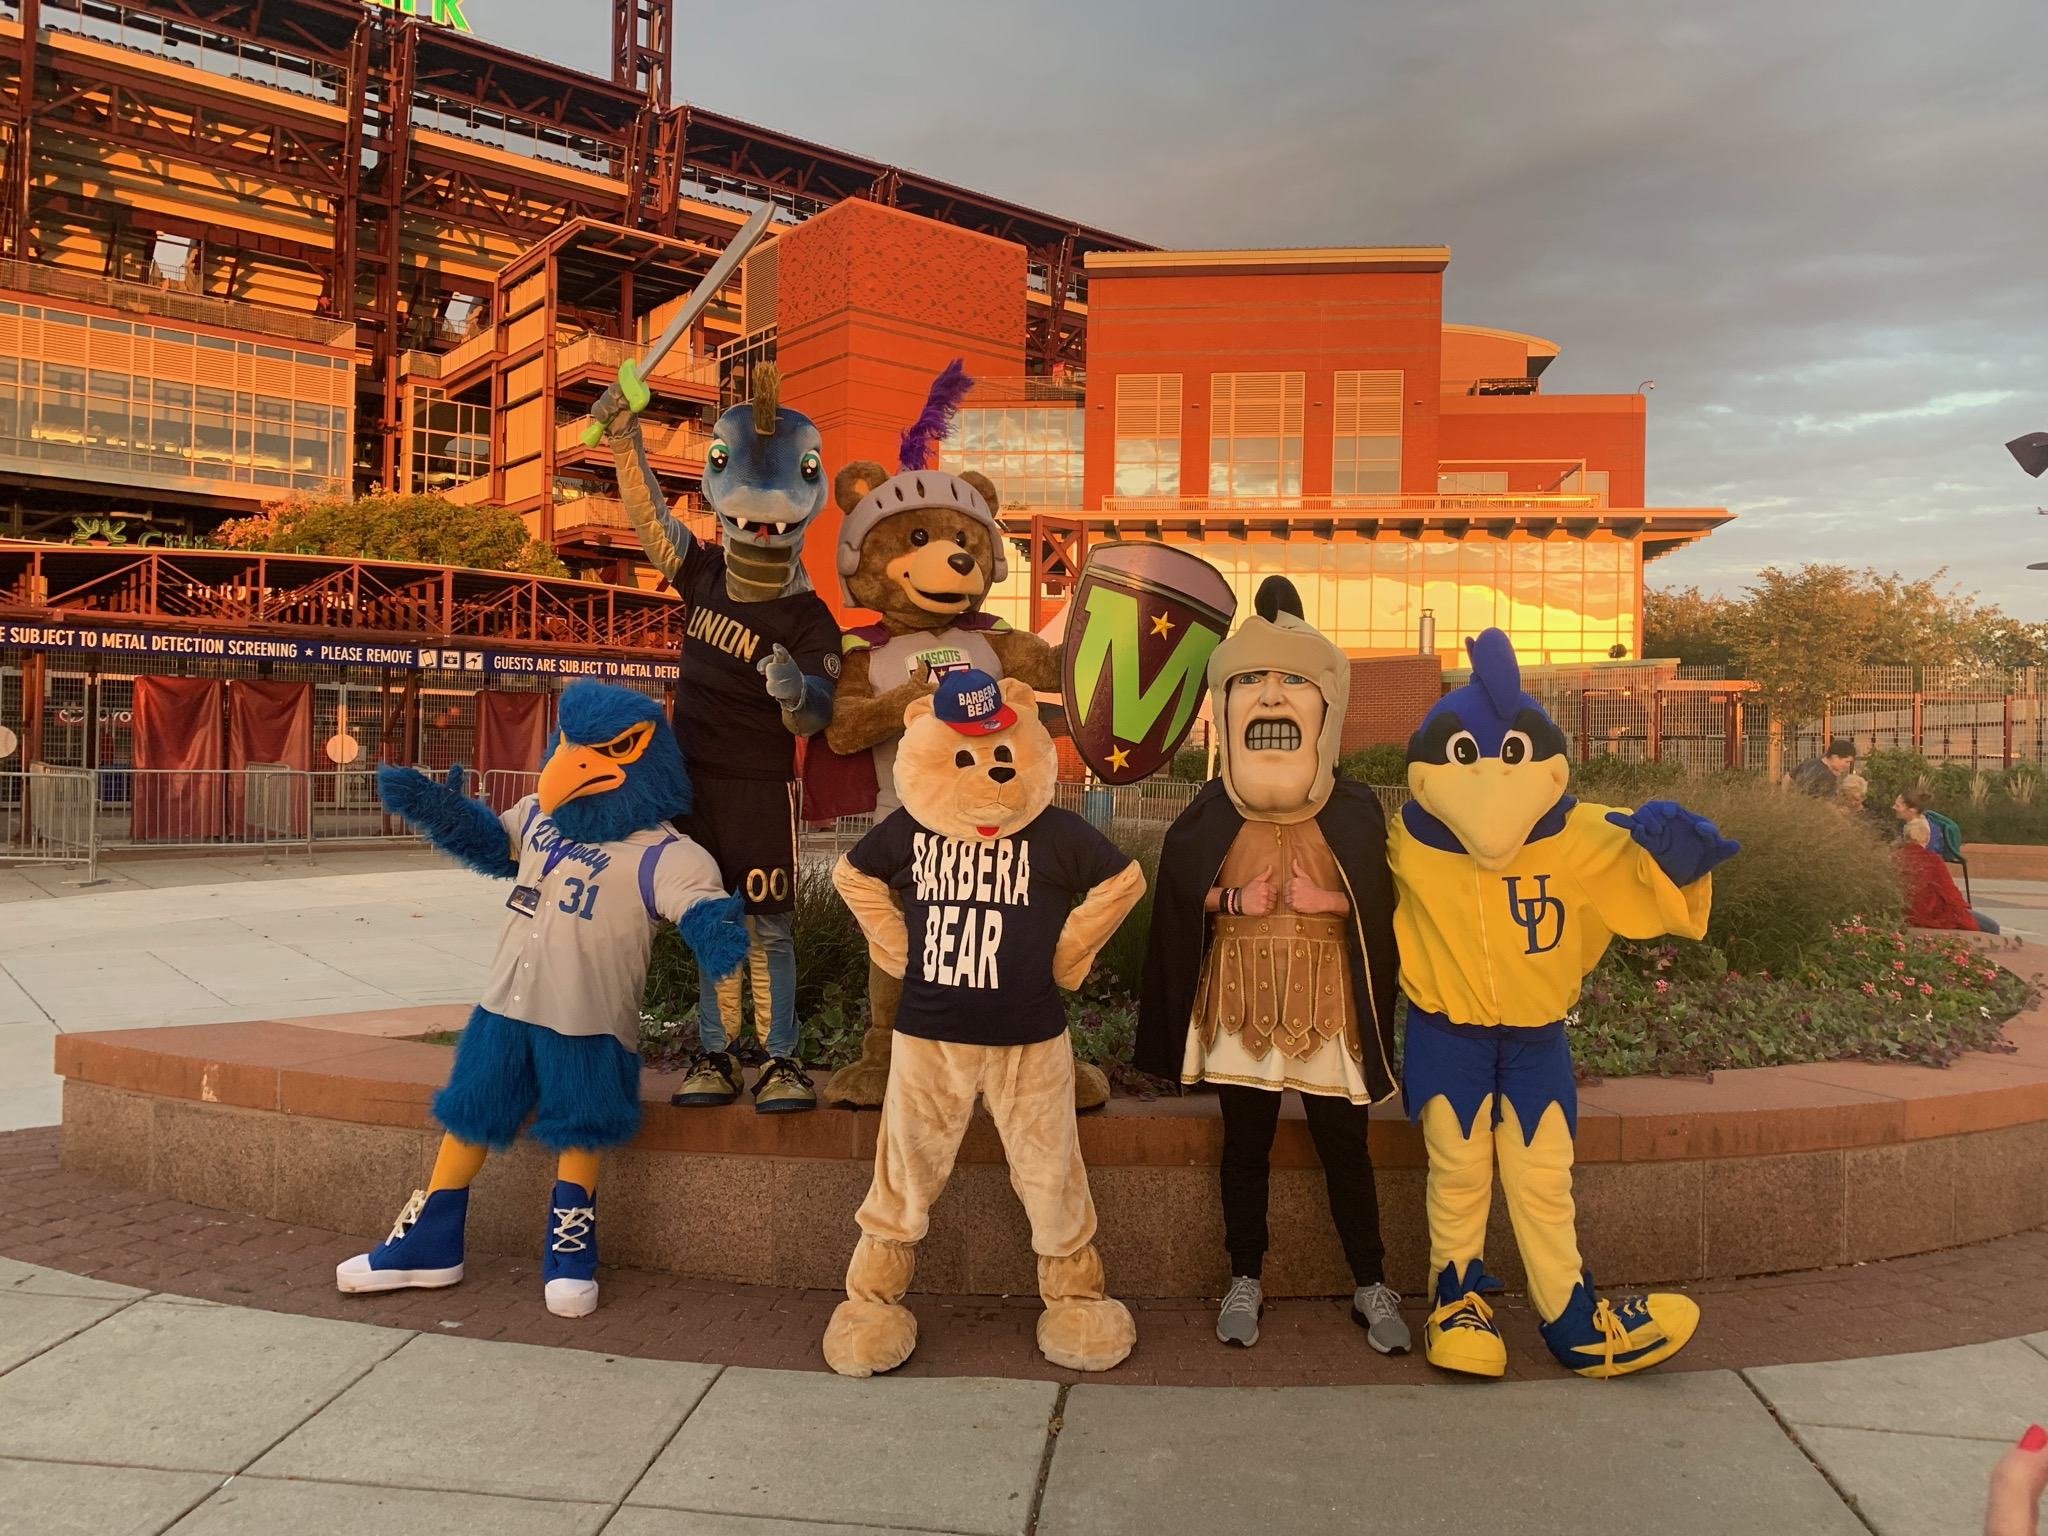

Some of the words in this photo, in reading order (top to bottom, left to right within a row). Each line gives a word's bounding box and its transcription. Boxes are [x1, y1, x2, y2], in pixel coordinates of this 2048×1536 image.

[10, 627, 75, 646] SUBJECT
[79, 631, 97, 647] TO
[102, 632, 147, 650] METAL
[152, 636, 224, 655] DETECTION
[228, 640, 297, 658] SCREENING
[321, 645, 363, 661] PLEASE
[366, 648, 412, 664] REMOVE
[686, 605, 760, 663] UNION
[494, 655, 533, 671] GUESTS
[536, 658, 556, 672] ARE
[559, 659, 602, 675] SUBJECT
[606, 662, 618, 675] TO
[620, 663, 652, 678] METAL
[916, 650, 962, 665] MASCOTS
[1074, 585, 1221, 753] M
[958, 683, 997, 706] BARBERA
[967, 699, 995, 718] BEAR
[746, 868, 788, 902] 00
[911, 832, 1031, 906] BARBERA
[559, 877, 600, 920] 31
[1502, 874, 1565, 954] UD
[923, 904, 1004, 990] BEAR
